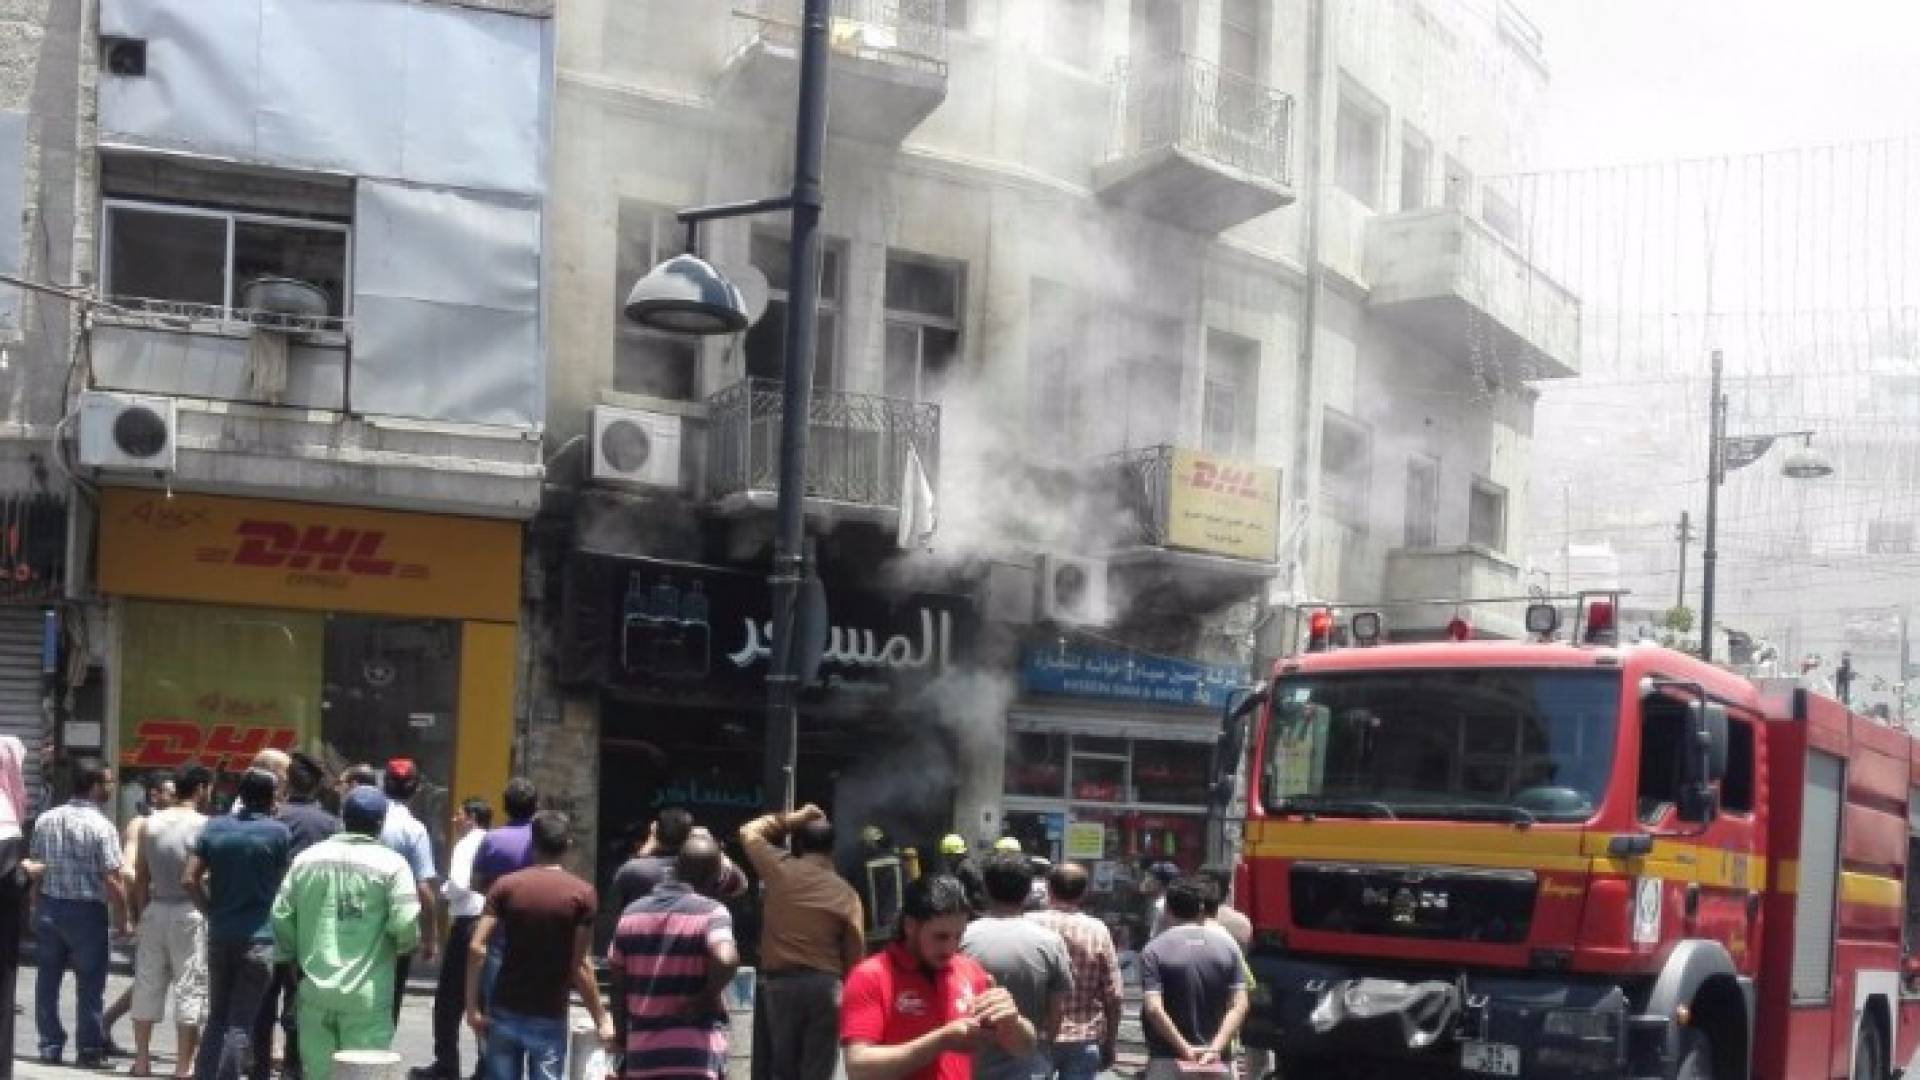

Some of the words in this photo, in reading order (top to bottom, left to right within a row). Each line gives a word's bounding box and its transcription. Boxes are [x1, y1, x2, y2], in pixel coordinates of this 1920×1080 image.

[1191, 461, 1259, 500] DHL
[233, 519, 396, 576] DHL
[728, 608, 950, 675] المسر
